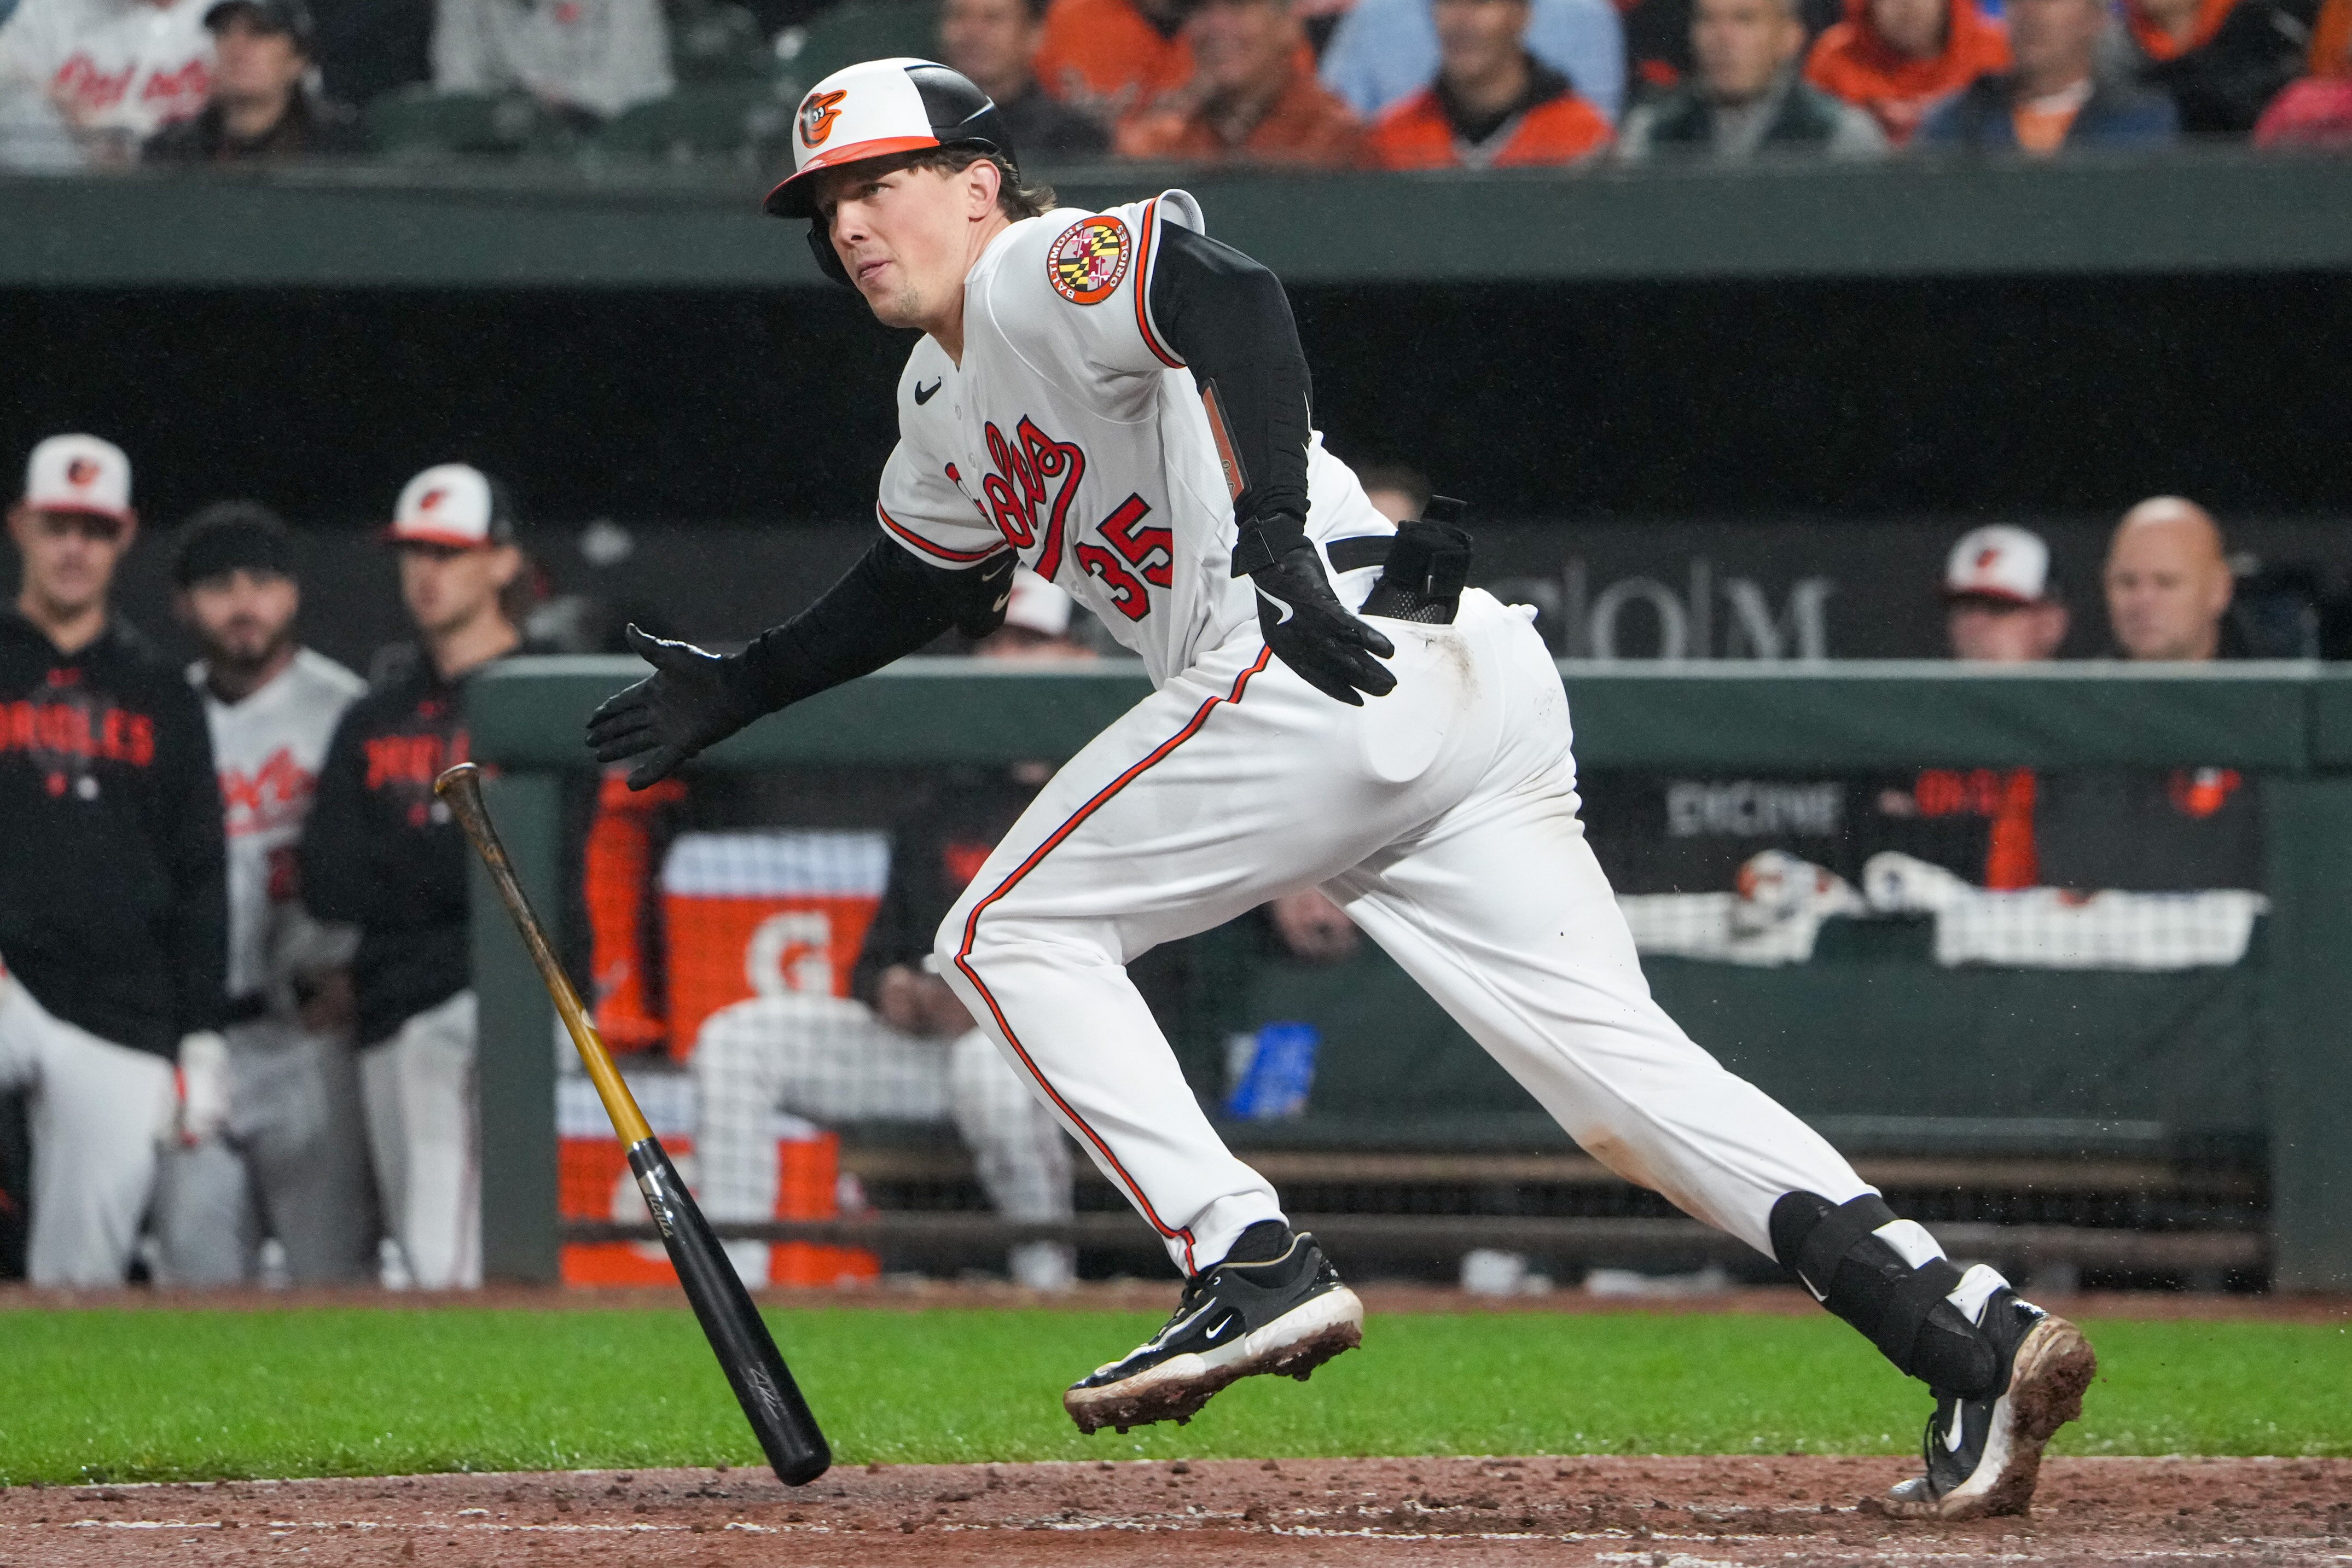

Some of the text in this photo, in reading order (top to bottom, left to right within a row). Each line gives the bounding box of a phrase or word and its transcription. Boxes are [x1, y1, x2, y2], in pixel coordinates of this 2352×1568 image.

[1049, 222, 1084, 299] BALTIMORE
[1109, 224, 1130, 288] ORIOLES
[945, 414, 1086, 583] oles
[1074, 492, 1173, 623] 35
